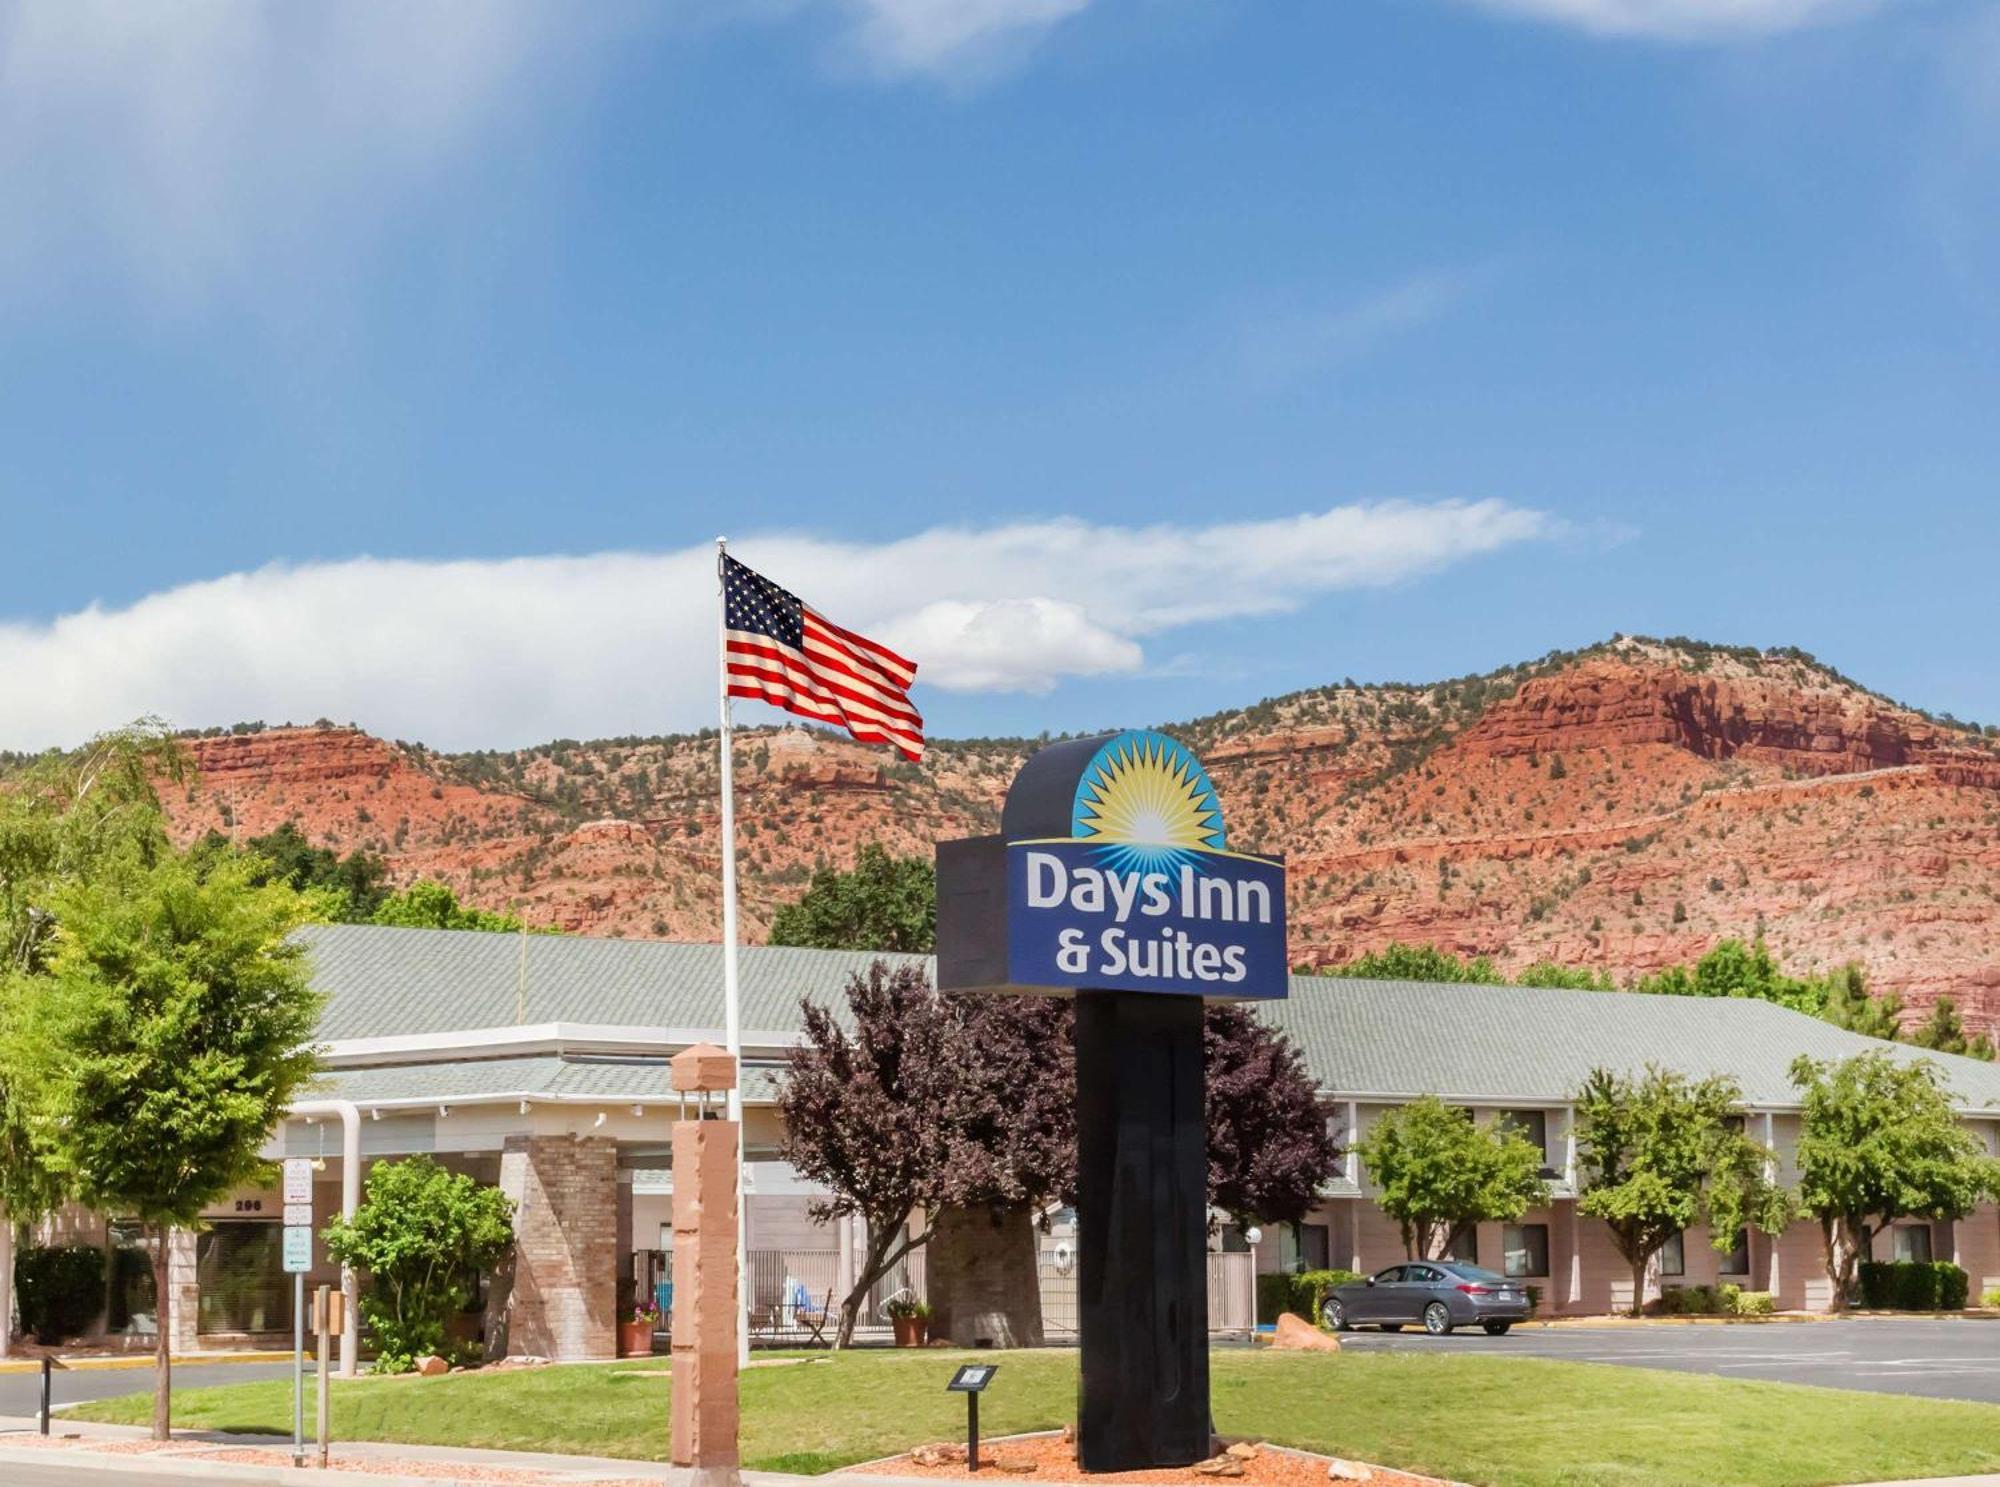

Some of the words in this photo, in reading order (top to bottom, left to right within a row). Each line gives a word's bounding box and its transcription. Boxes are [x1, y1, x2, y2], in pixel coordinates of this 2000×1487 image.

[1027, 853, 1170, 922] Days
[1181, 865, 1271, 923] Inn
[1056, 929, 1090, 973] &
[1101, 927, 1247, 982] Suites
